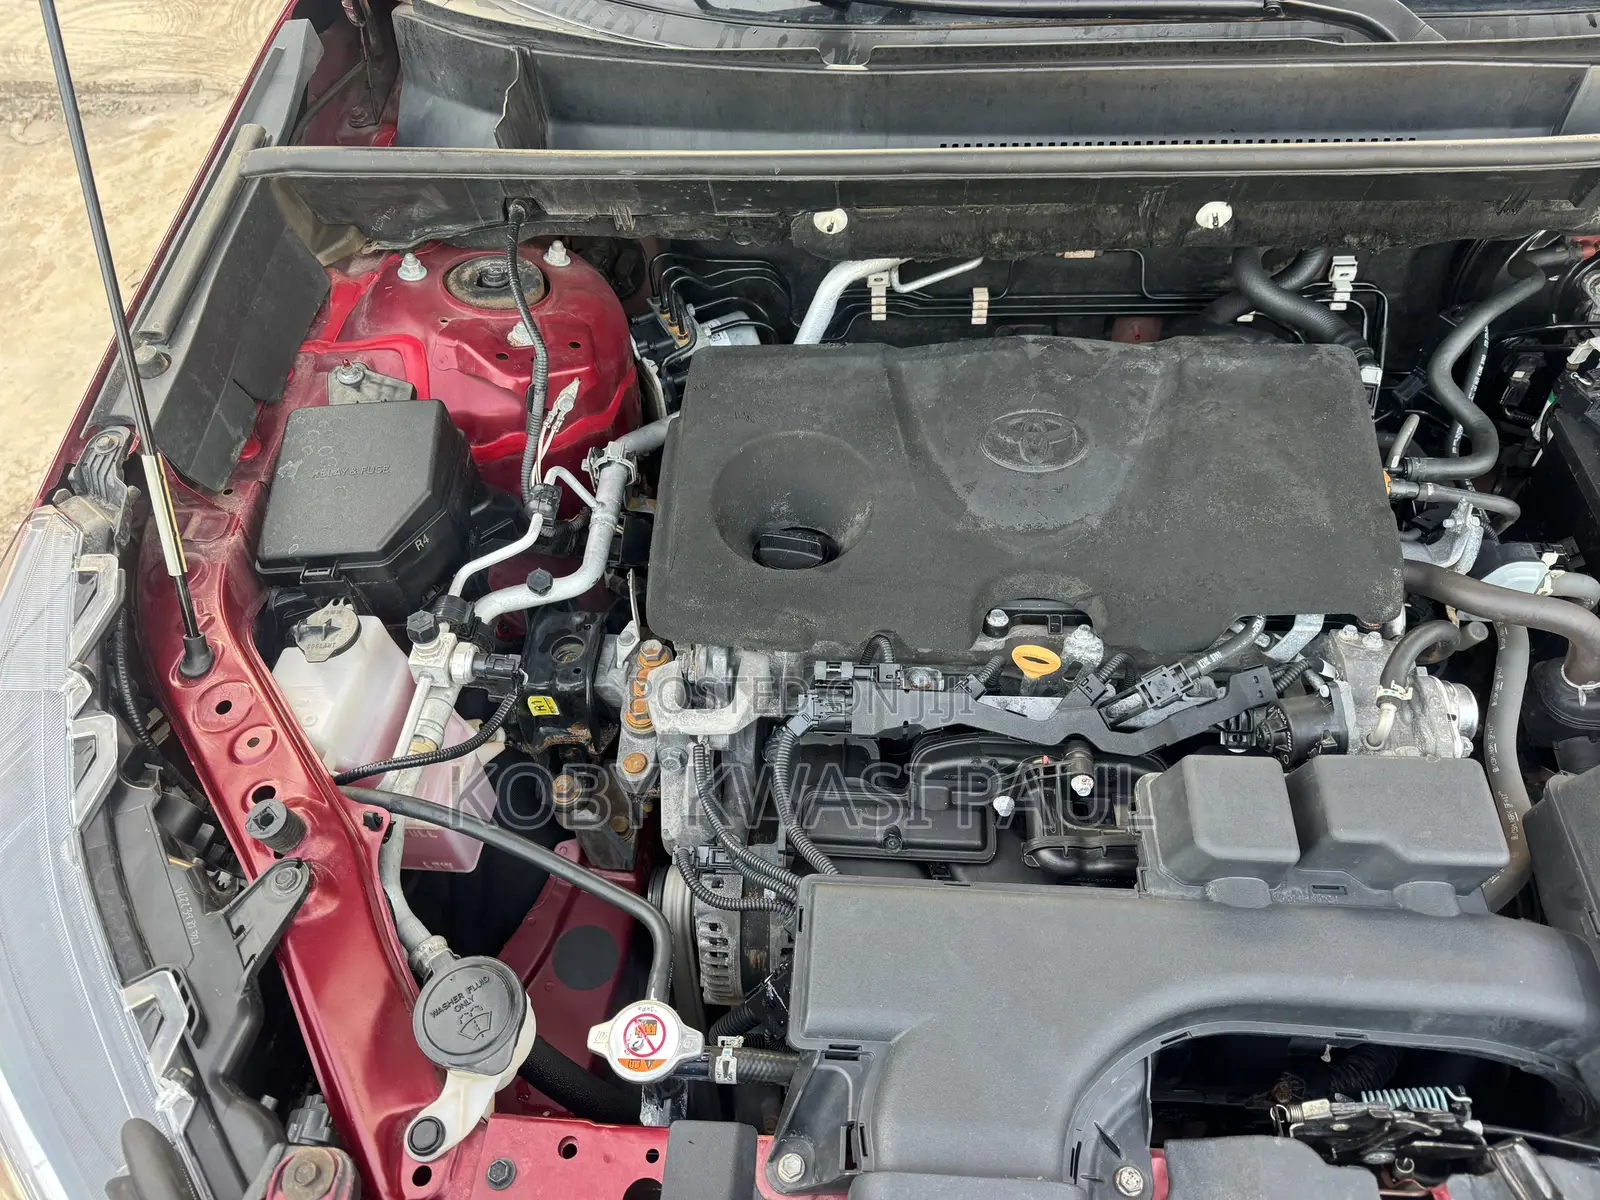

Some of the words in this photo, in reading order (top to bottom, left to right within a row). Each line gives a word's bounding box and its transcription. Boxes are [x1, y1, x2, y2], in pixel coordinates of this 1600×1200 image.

[312, 467, 349, 479] RELAY
[350, 466, 358, 476] &
[361, 464, 391, 476] FUSE
[414, 533, 430, 551] R4
[430, 992, 465, 1018] WASHER
[466, 976, 490, 994] FLUID
[454, 994, 474, 1012] ONLY
